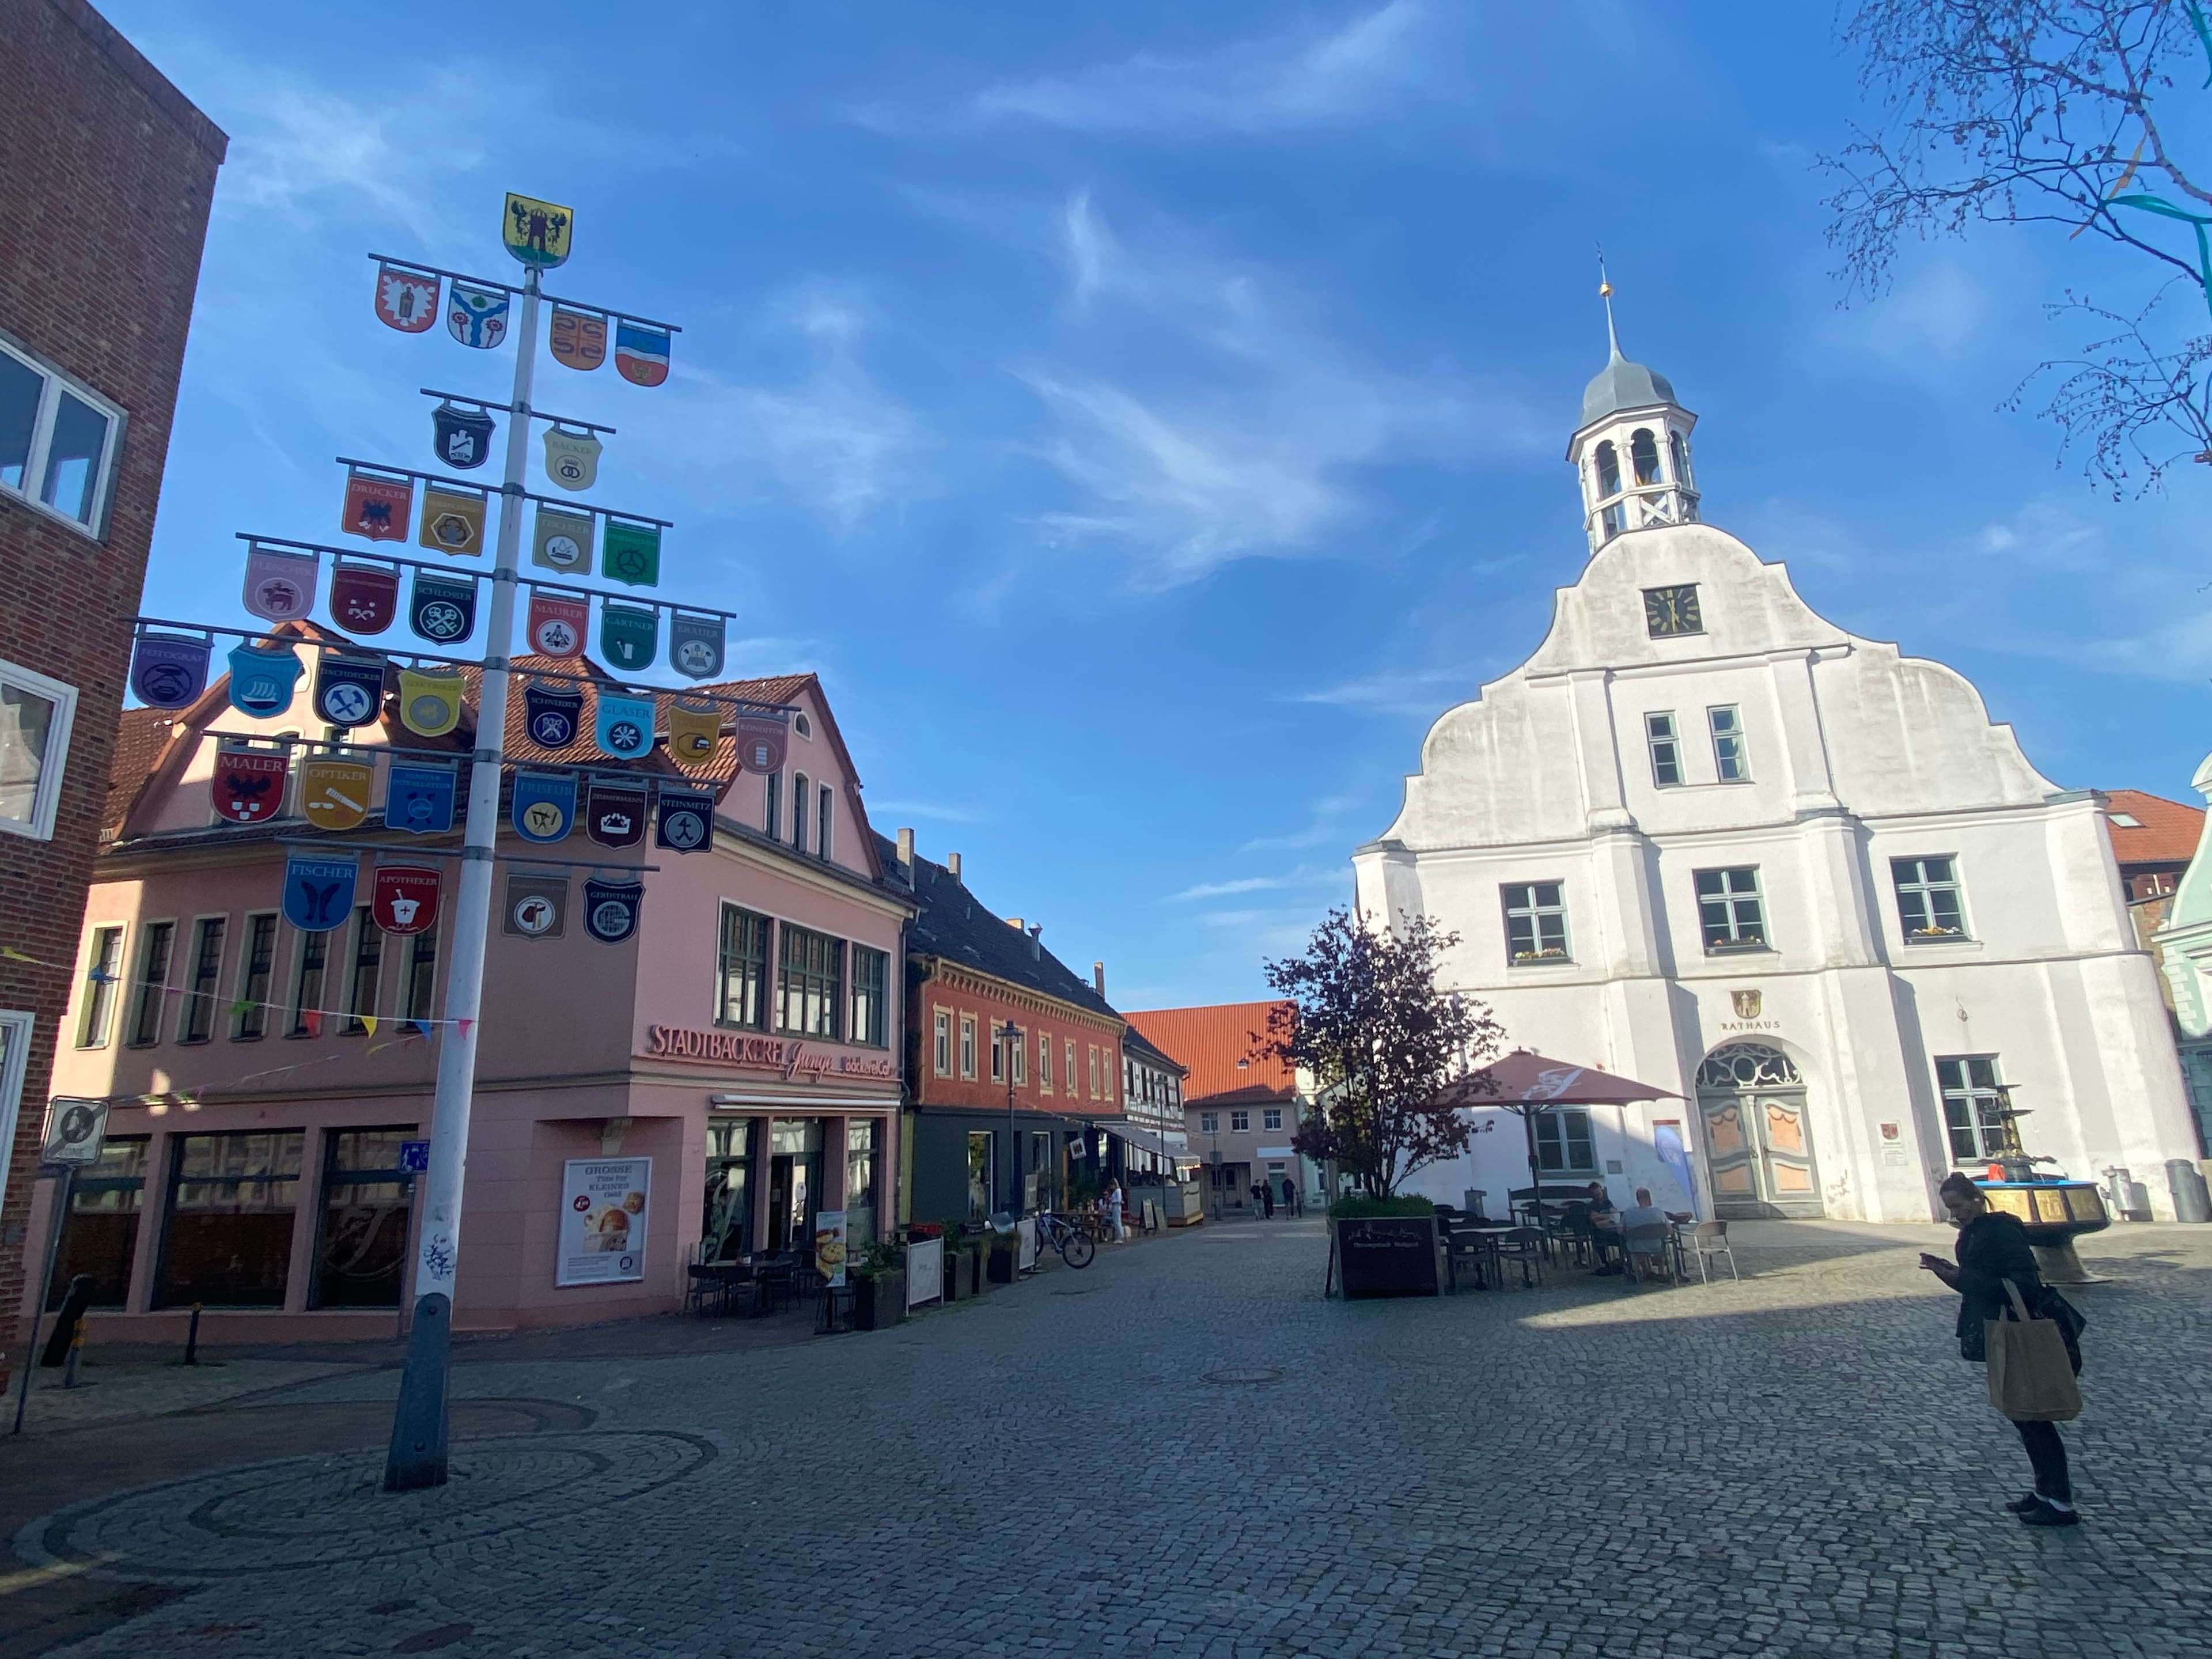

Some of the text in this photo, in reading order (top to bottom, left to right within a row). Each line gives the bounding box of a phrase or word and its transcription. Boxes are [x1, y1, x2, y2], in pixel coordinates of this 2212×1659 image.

[351, 483, 408, 500] DRUCKER
[416, 587, 471, 600] SCHLOSSER
[535, 604, 584, 619] MAURER
[677, 625, 718, 638] BRAUER
[141, 647, 204, 662] FOTOGRAF
[320, 667, 381, 681] DACHDECKER
[531, 696, 579, 709] SCHNEIDER
[601, 704, 651, 719] GLASER
[740, 724, 784, 734] KONDITOR
[221, 756, 284, 772] MALER
[308, 769, 368, 781] OPTIKER
[520, 782, 573, 796] FRISEUR
[592, 793, 644, 804] ZIMMERMANN
[661, 799, 711, 811] STEINMETZ
[291, 864, 353, 879] FISCHER
[378, 875, 438, 886] APOTHEKER
[1721, 1021, 1781, 1031] RATHAUS
[585, 1165, 632, 1176] GROSSE
[588, 1183, 630, 1191] KLEINES
